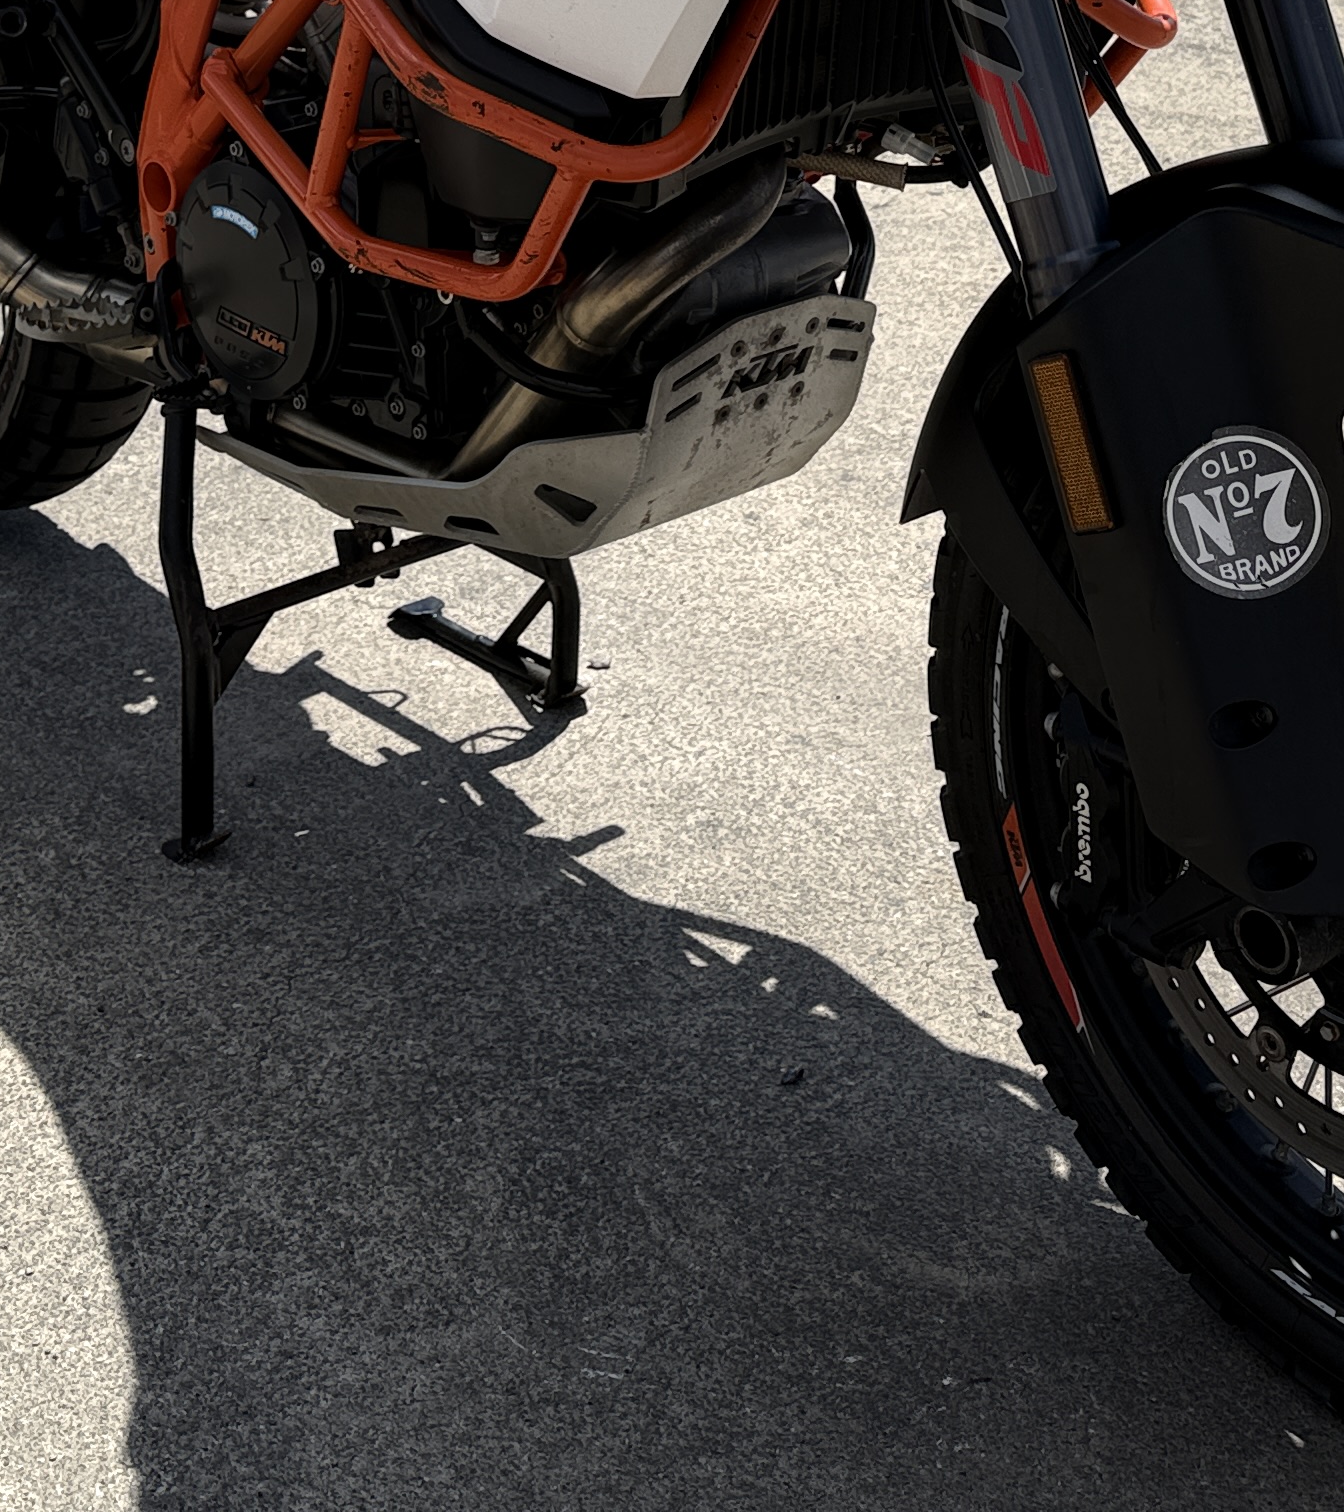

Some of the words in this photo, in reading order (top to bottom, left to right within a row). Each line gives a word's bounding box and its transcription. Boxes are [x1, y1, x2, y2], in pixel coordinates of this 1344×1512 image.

[249, 325, 288, 354] KTM
[720, 343, 815, 400] KTM
[1201, 449, 1257, 479] OLD
[1218, 545, 1301, 581] BRAND
[1073, 781, 1092, 884] brembo
